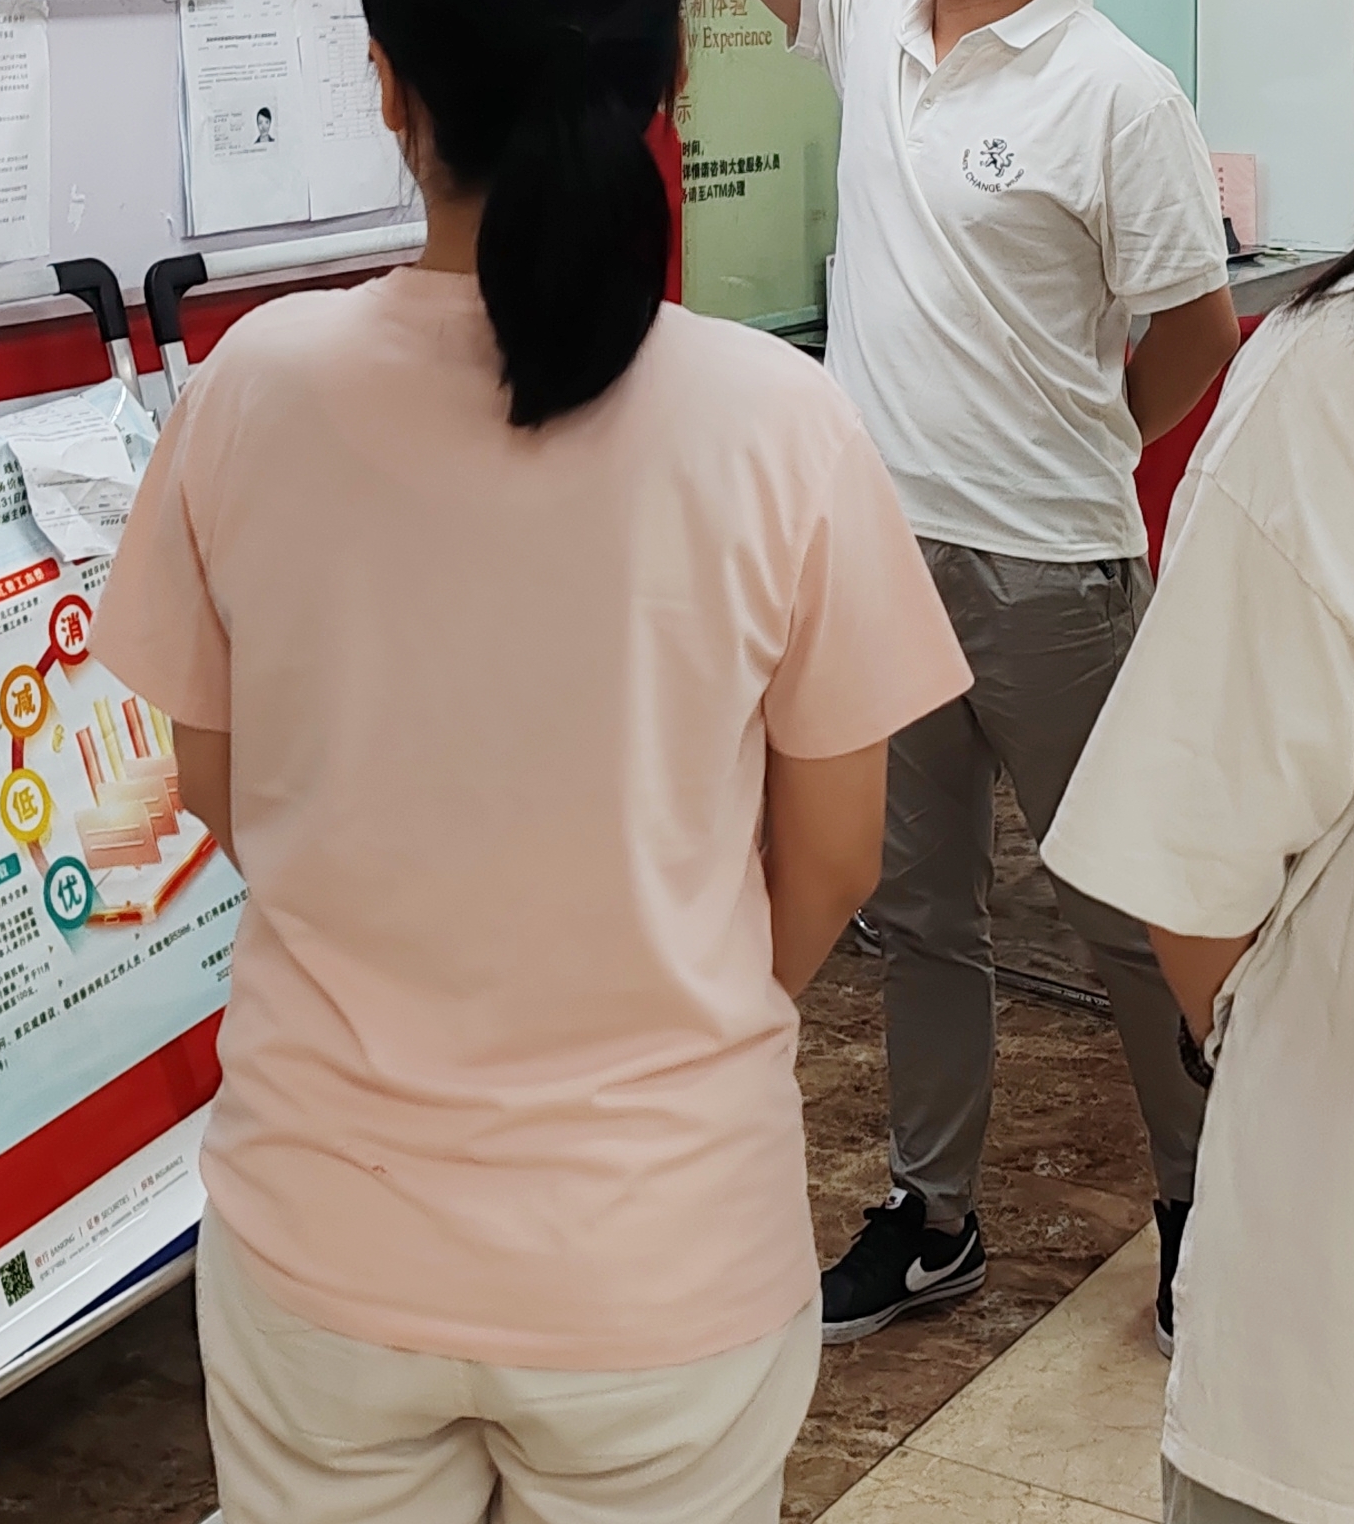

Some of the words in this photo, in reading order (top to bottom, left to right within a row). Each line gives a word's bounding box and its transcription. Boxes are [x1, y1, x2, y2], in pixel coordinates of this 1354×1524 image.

[703, 28, 772, 53] Experience
[60, 611, 84, 649] 消
[12, 682, 36, 719] 减
[12, 786, 38, 824] 低
[56, 875, 82, 914] 优
